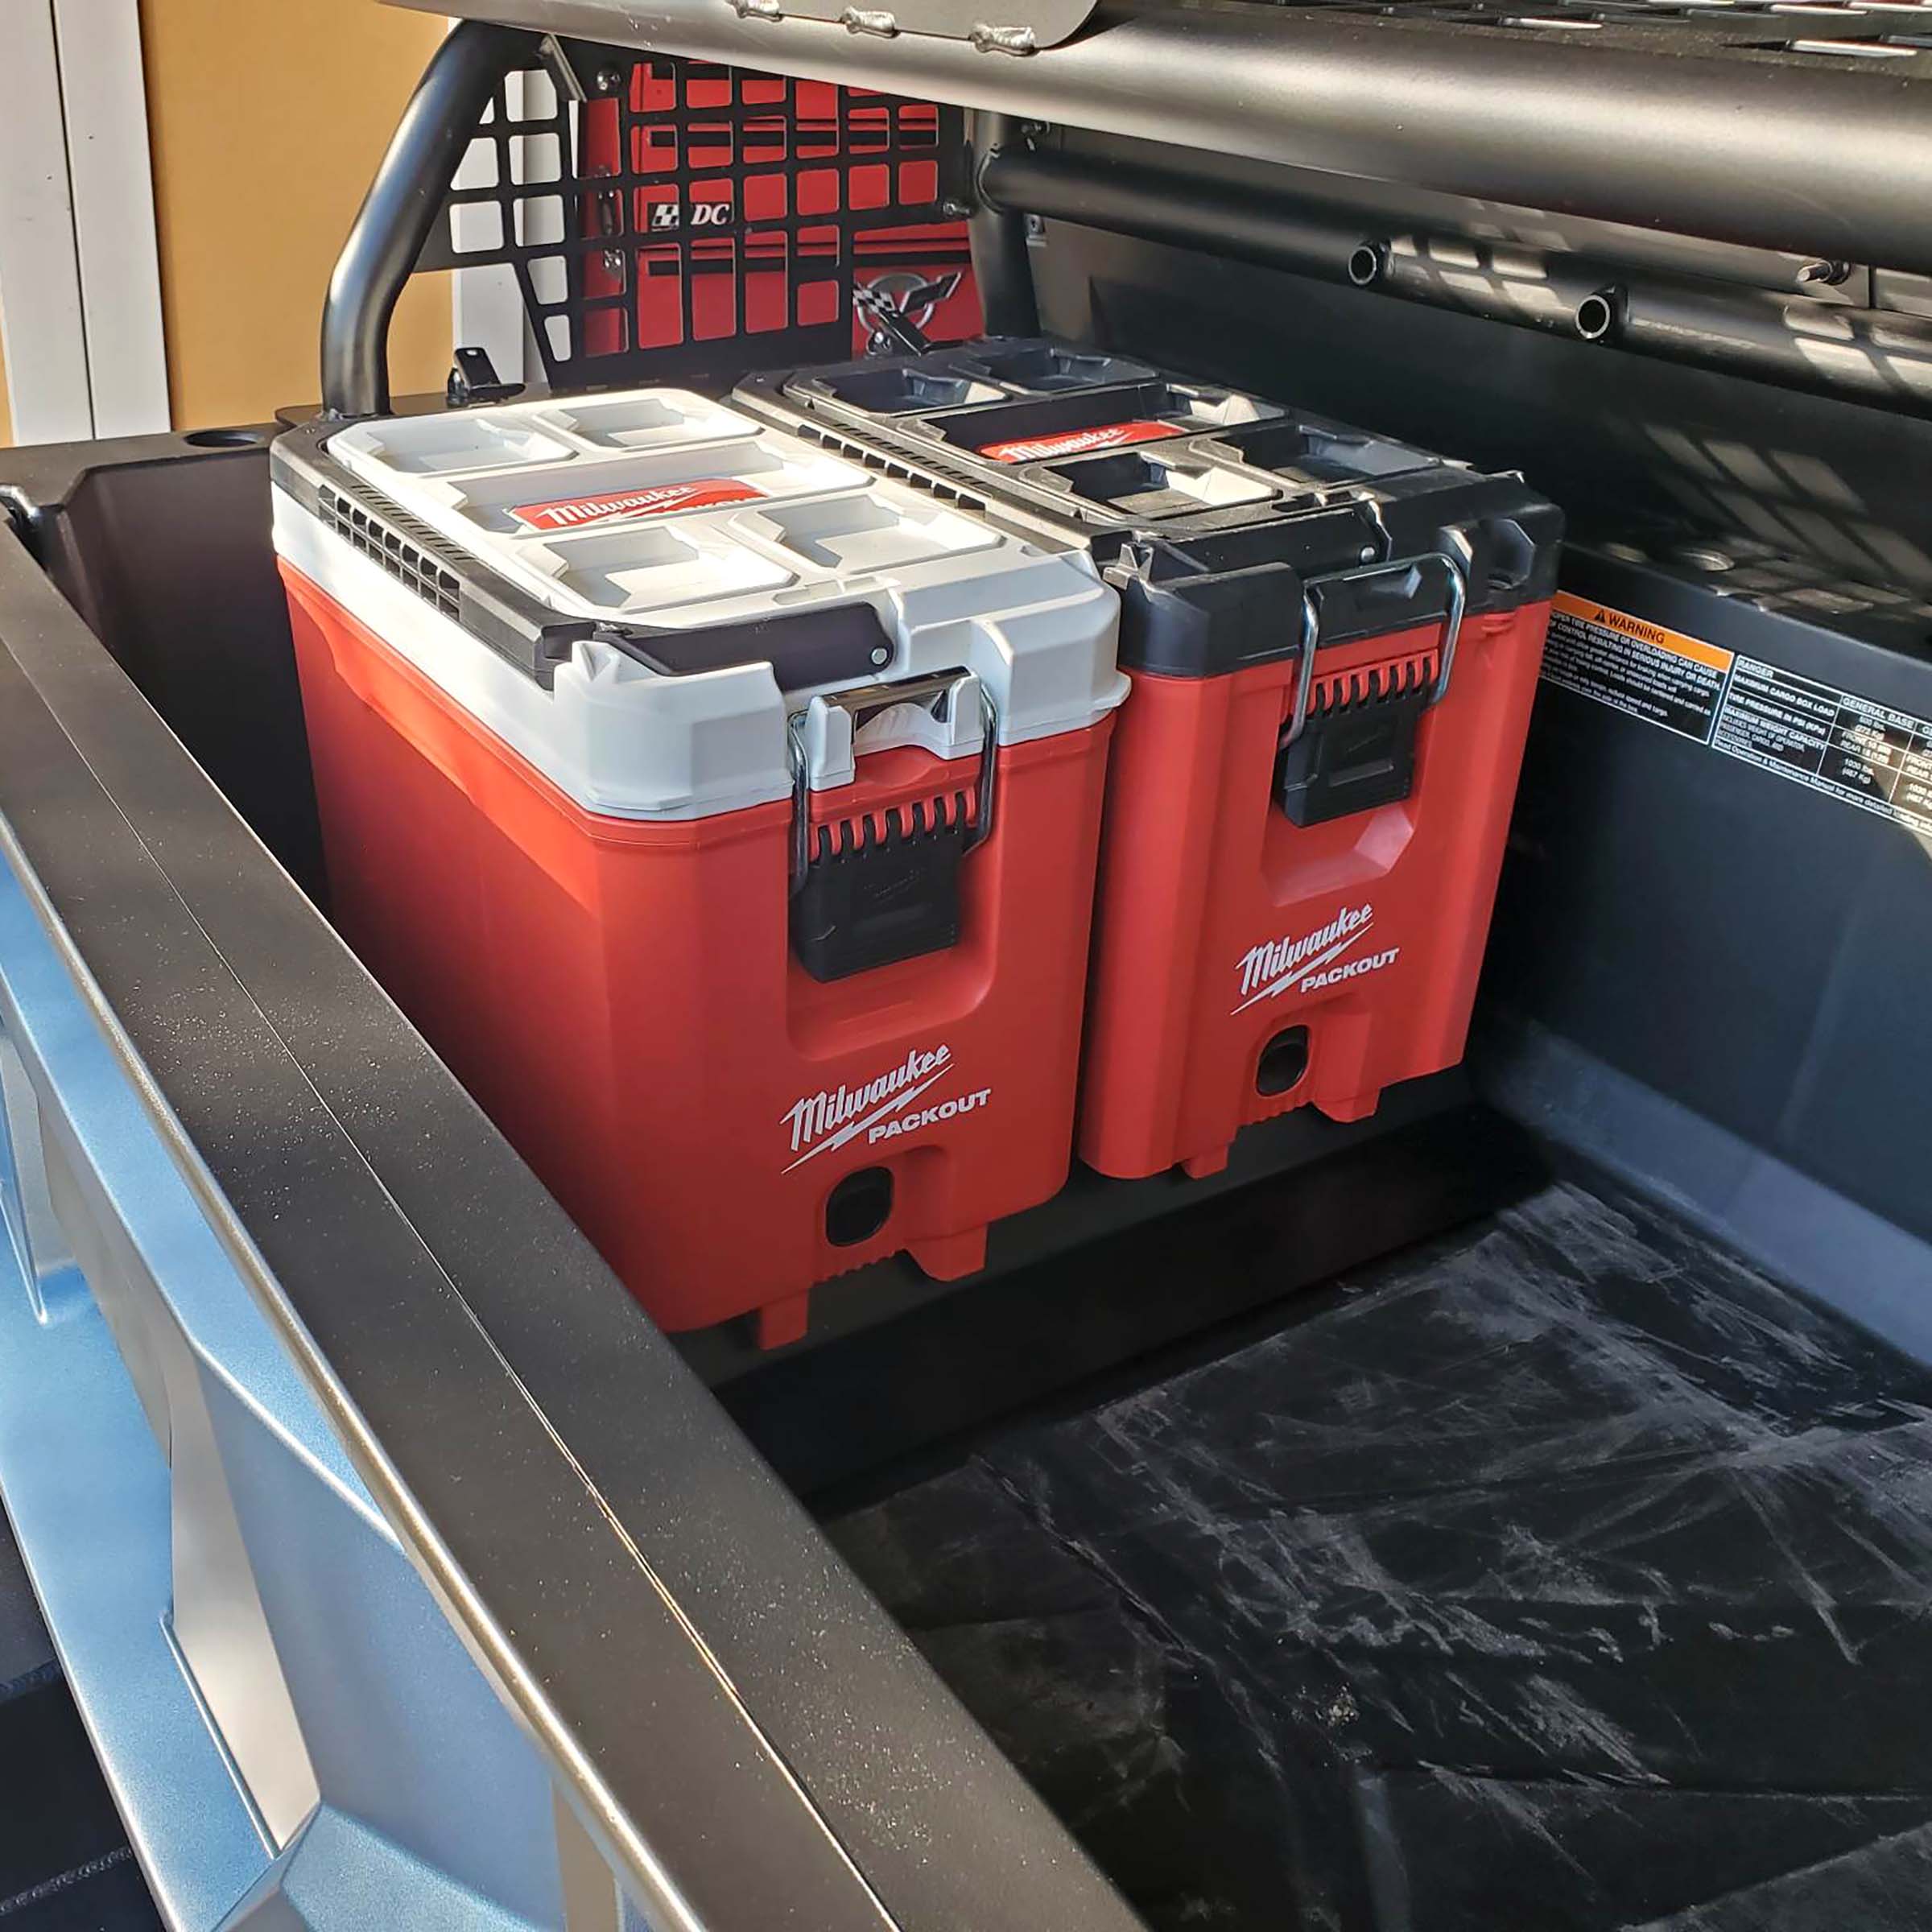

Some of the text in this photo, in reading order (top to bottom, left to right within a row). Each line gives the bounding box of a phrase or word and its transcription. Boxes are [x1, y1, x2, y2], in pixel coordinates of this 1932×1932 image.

[691, 203, 731, 226] DC
[998, 427, 1126, 461] Milwaukee
[535, 486, 699, 526] Milwaukee
[1585, 623, 1620, 642] PRESSURE
[1620, 636, 1630, 646] OR
[1629, 639, 1678, 663] OVERLOADING
[1677, 657, 1694, 670] CAN
[1693, 663, 1718, 679] CAUSE
[1608, 614, 1665, 643] WARNING
[1557, 622, 1587, 639] CONTROL
[1587, 634, 1624, 653] RESULTING
[1623, 646, 1632, 656] IN
[1631, 650, 1661, 667] SERIOUS
[1660, 661, 1685, 677] INJURY
[1685, 670, 1696, 681] OR
[1737, 658, 1773, 679] RANGER
[1728, 691, 1745, 704] TIRE
[1744, 697, 1783, 719] PRESSURE
[1783, 712, 1792, 722] IN
[1792, 716, 1806, 728] PSI
[1733, 673, 1835, 718] MAXIMUM CARGO BOX LOAD
[1842, 695, 1886, 720] GENERAL
[1887, 712, 1914, 730] BASE
[1724, 705, 1826, 751] MAXIMUM WEIGHT CAPACITY
[1731, 745, 1762, 764] Operation
[1768, 759, 1809, 782] Maintenance
[1810, 776, 1835, 793] Manual
[1835, 786, 1845, 796] for
[1846, 791, 1864, 804] more
[1864, 797, 1893, 816] detailed
[1235, 904, 1373, 995] Milwaukee
[1301, 947, 1399, 993] PACKOUT
[779, 1044, 952, 1151] Milwaukee
[868, 1088, 991, 1144] PACKOUT
